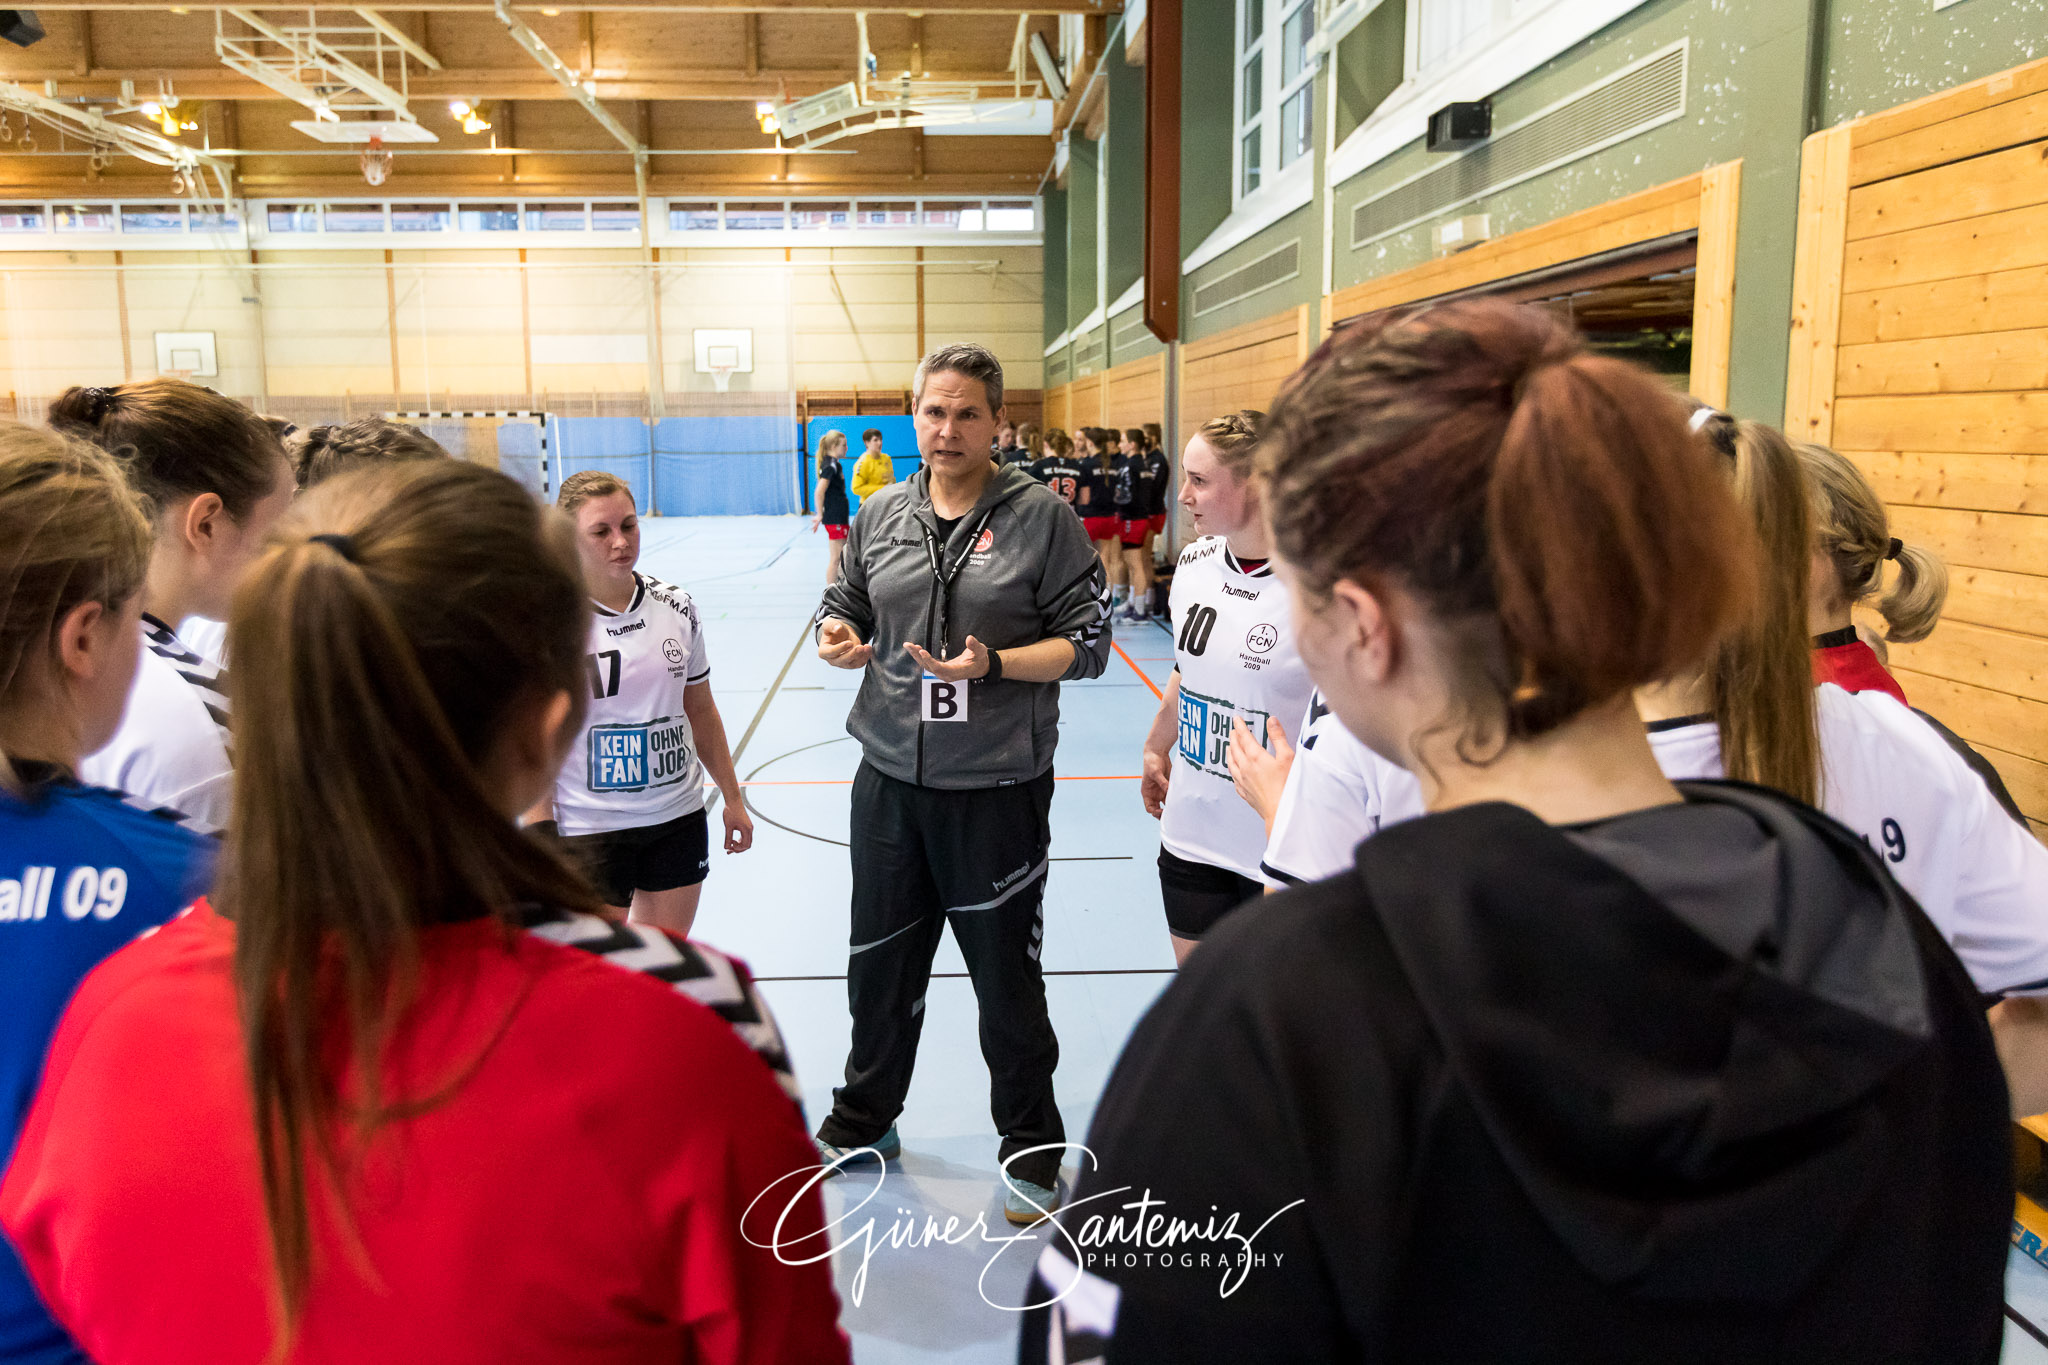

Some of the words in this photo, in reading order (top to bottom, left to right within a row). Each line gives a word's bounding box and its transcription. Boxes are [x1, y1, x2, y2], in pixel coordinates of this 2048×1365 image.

[1048, 477, 1076, 504] 13
[891, 536, 923, 547] hummel
[1180, 544, 1217, 566] MANN
[1221, 582, 1260, 601] hummel
[606, 619, 646, 636] hummel
[1178, 603, 1217, 656] 10
[1261, 626, 1269, 635] 1.
[666, 649, 681, 658] FCN
[1249, 635, 1272, 647] FCN
[1239, 652, 1271, 665] Handball
[1243, 661, 1261, 671] 2009
[931, 682, 958, 719] B
[1179, 697, 1201, 729] EIN
[1211, 711, 1254, 738] OH
[600, 734, 641, 756] KEIN
[1210, 738, 1231, 769] JO
[601, 757, 641, 783] FAN
[653, 747, 686, 778] JOB
[1880, 817, 1906, 863] 9
[992, 861, 1030, 892] hummel
[62, 866, 128, 921] 09
